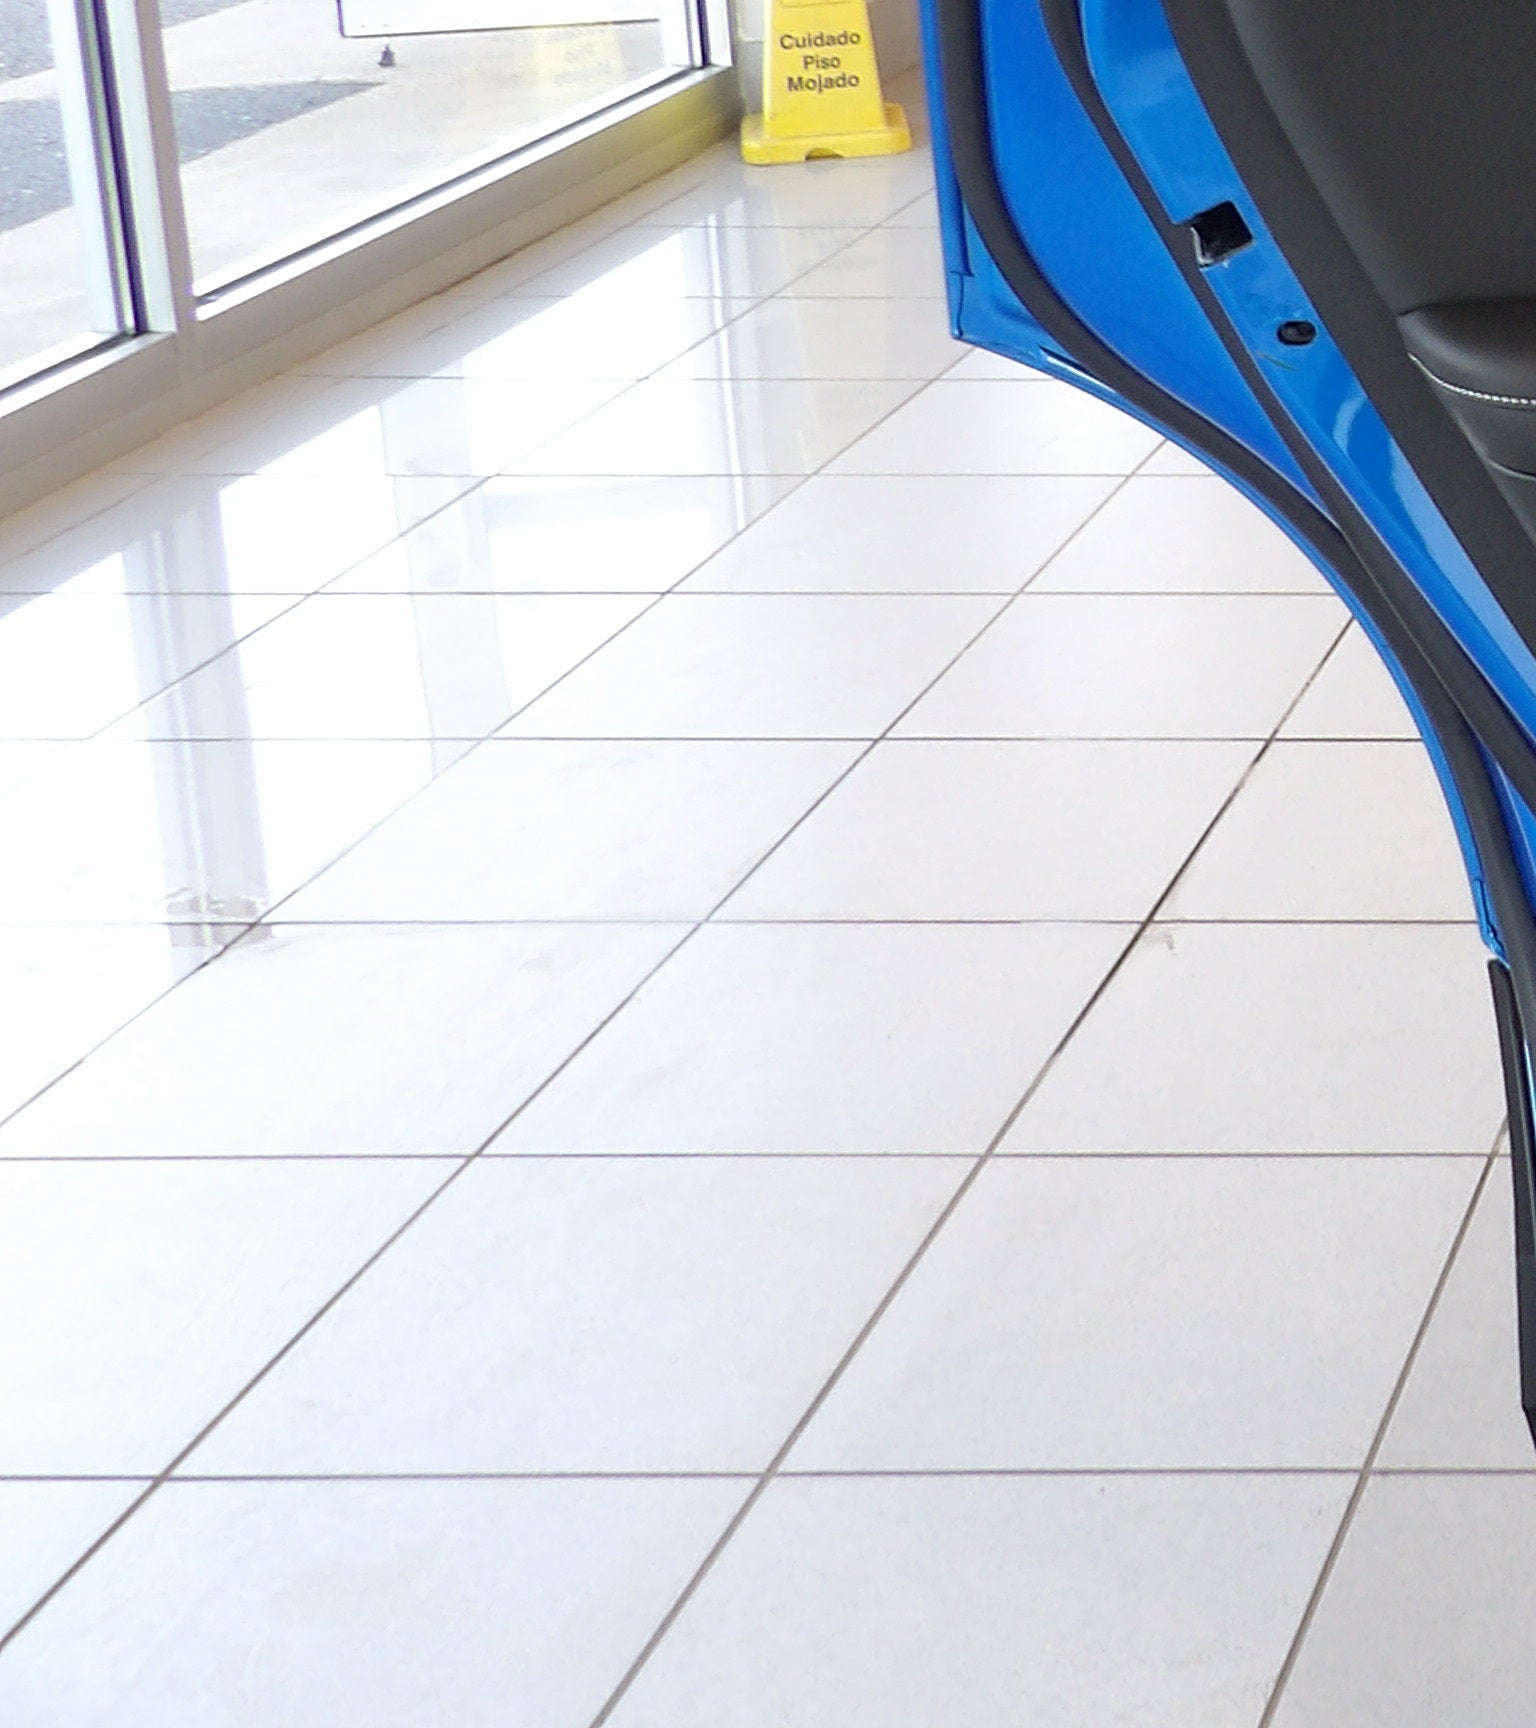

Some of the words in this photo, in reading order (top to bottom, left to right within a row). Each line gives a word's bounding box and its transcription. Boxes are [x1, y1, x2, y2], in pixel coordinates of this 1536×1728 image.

[780, 30, 862, 50] Cuidado
[803, 54, 841, 70] Piso
[787, 72, 860, 94] Mojado
